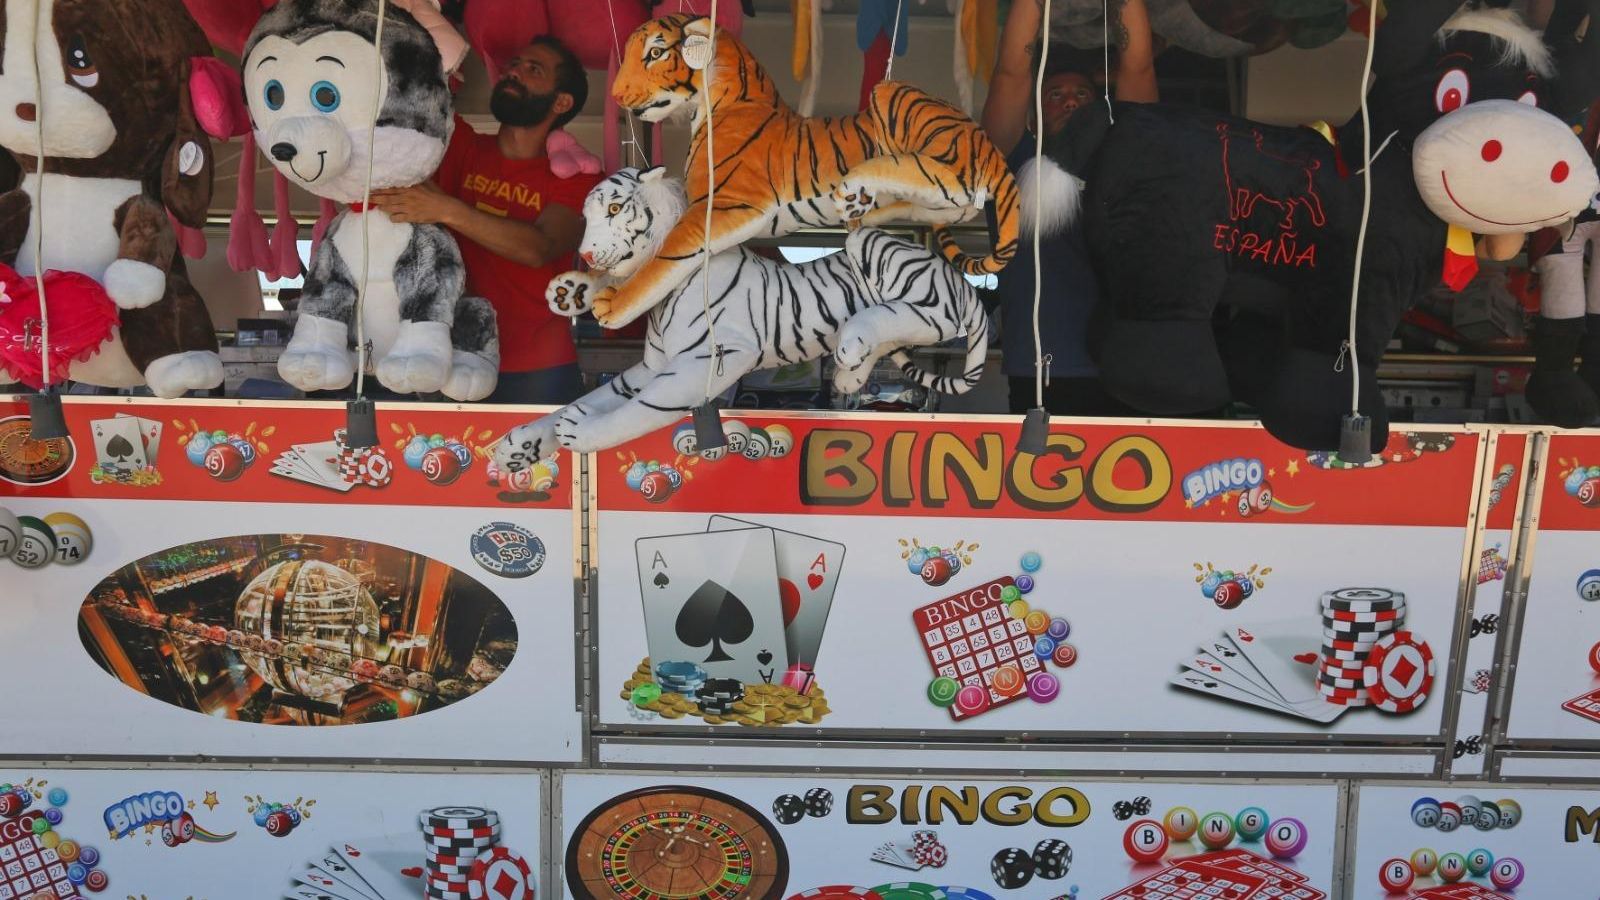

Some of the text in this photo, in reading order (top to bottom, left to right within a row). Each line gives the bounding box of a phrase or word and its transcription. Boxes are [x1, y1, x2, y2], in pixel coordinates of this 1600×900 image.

[463, 173, 542, 211] ESPAÑA
[1213, 224, 1316, 268] ESPAÑA
[704, 450, 718, 458] 21
[729, 442, 742, 451] 37
[746, 449, 760, 458] 52
[771, 446, 785, 455] 74
[800, 428, 1173, 513] BINGO
[1187, 462, 1262, 503] BINGO
[24, 541, 33, 549] G
[61, 537, 69, 545] O
[16, 550, 38, 564] 52
[57, 547, 80, 560] 74
[499, 546, 532, 564] $50
[652, 550, 667, 569] A
[810, 553, 826, 573] A
[923, 583, 1004, 626] BINGO
[929, 632, 938, 642] 11
[945, 625, 960, 637] 35
[969, 618, 977, 627] 4
[985, 610, 999, 620] 48
[937, 652, 944, 661] 8
[953, 643, 967, 655] 23
[973, 635, 987, 647] 65
[993, 630, 1001, 639] 5
[1012, 622, 1023, 632] 13
[961, 661, 972, 671] 12
[983, 654, 989, 663] 7
[998, 646, 1012, 657] 28
[1017, 638, 1029, 650] 27
[1024, 657, 1037, 669] 33
[1001, 671, 1013, 685] N
[109, 795, 180, 834] BINGO
[846, 785, 1092, 828] BINGO
[0, 816, 34, 843] GO
[1143, 814, 1292, 845] B I N G O
[1440, 821, 1451, 829] 21
[4, 840, 32, 856] 4 48
[27, 859, 35, 868] 5
[44, 850, 55, 860] 13
[1394, 866, 1403, 879] B
[1448, 859, 1457, 869] N
[1475, 855, 1484, 865] G
[1500, 865, 1511, 876] O
[32, 873, 46, 884] 28
[58, 882, 71, 894] 33
